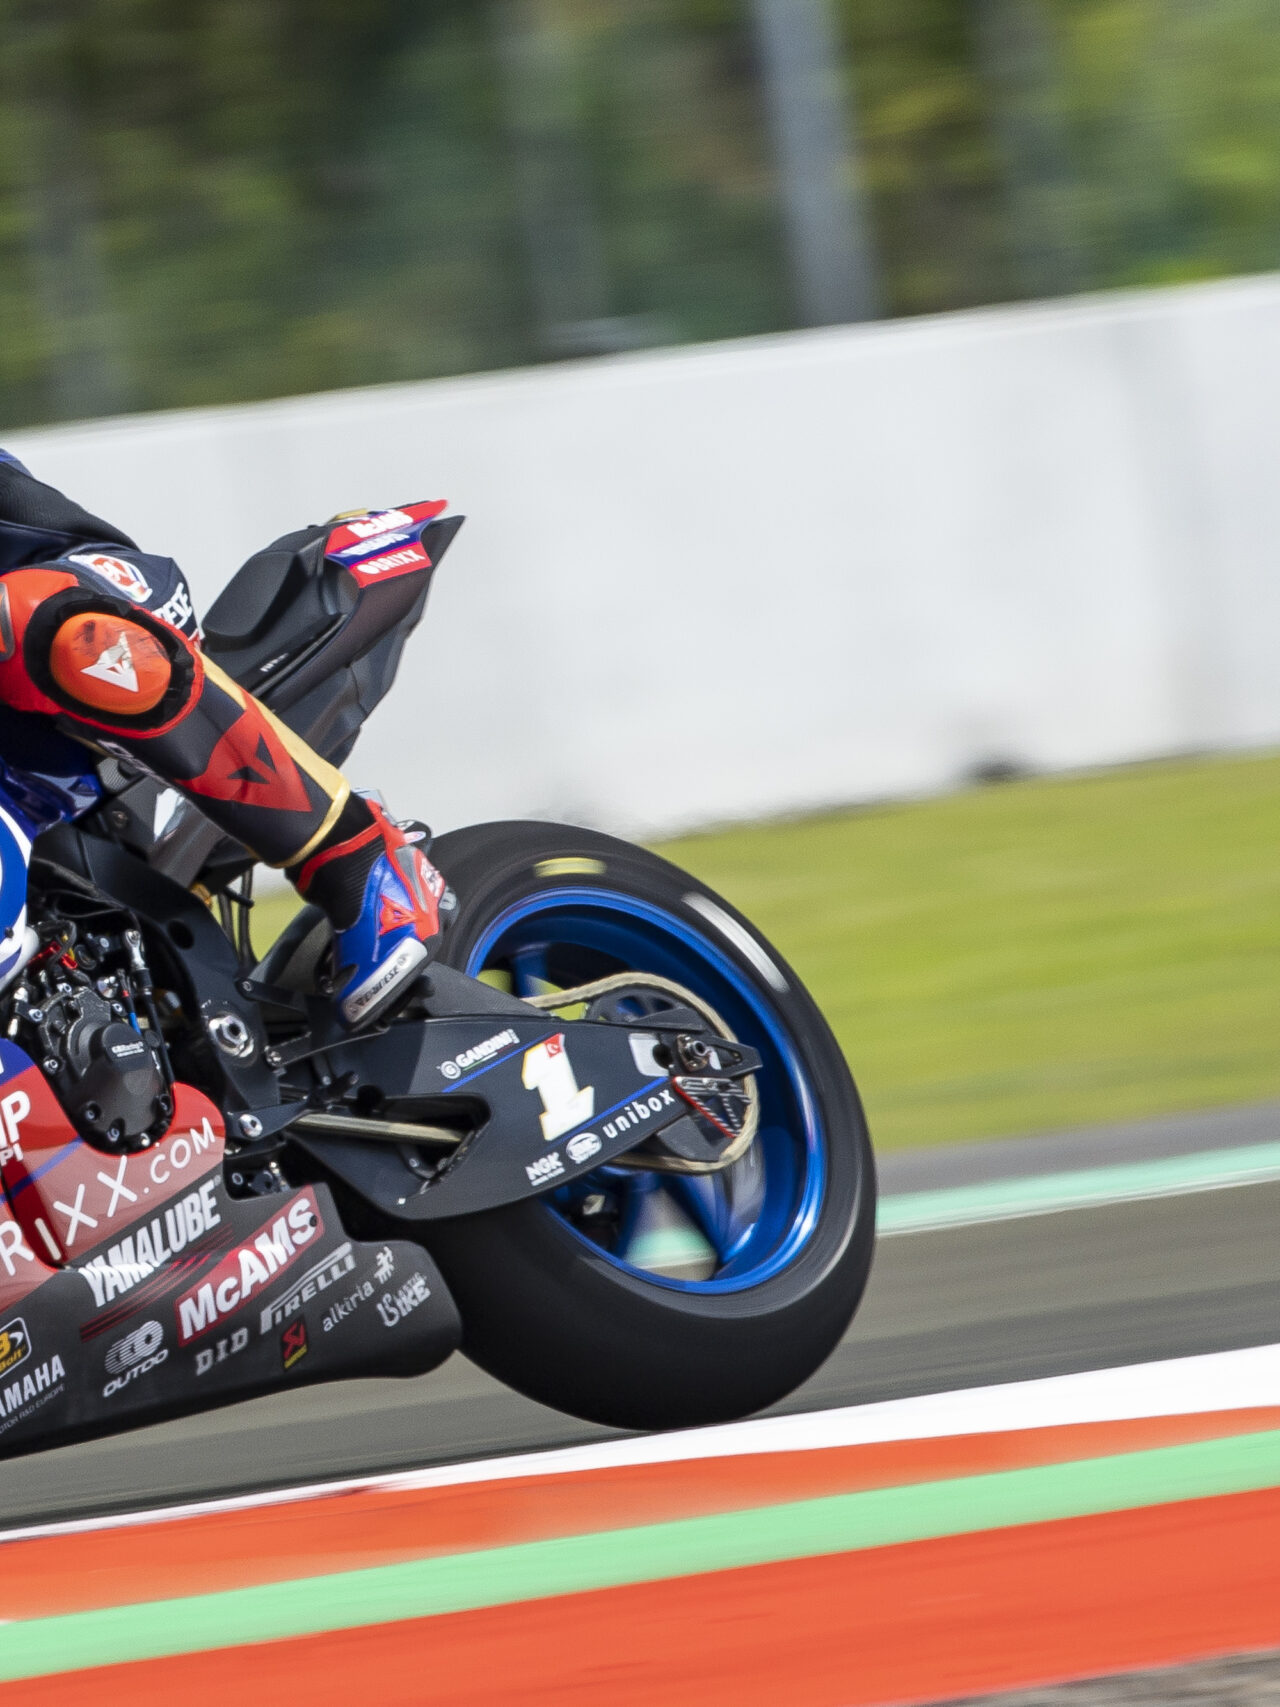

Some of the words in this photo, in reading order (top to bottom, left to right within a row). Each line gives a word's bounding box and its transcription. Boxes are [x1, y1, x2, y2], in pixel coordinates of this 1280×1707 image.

[521, 1032, 596, 1142] 1
[602, 1089, 676, 1139] unibox
[525, 1151, 564, 1181] NGK
[78, 1184, 221, 1308] YAMALUBE
[180, 1198, 320, 1341] McAMS
[260, 1241, 357, 1335] PIRELLI
[102, 1348, 169, 1398] OUTDO
